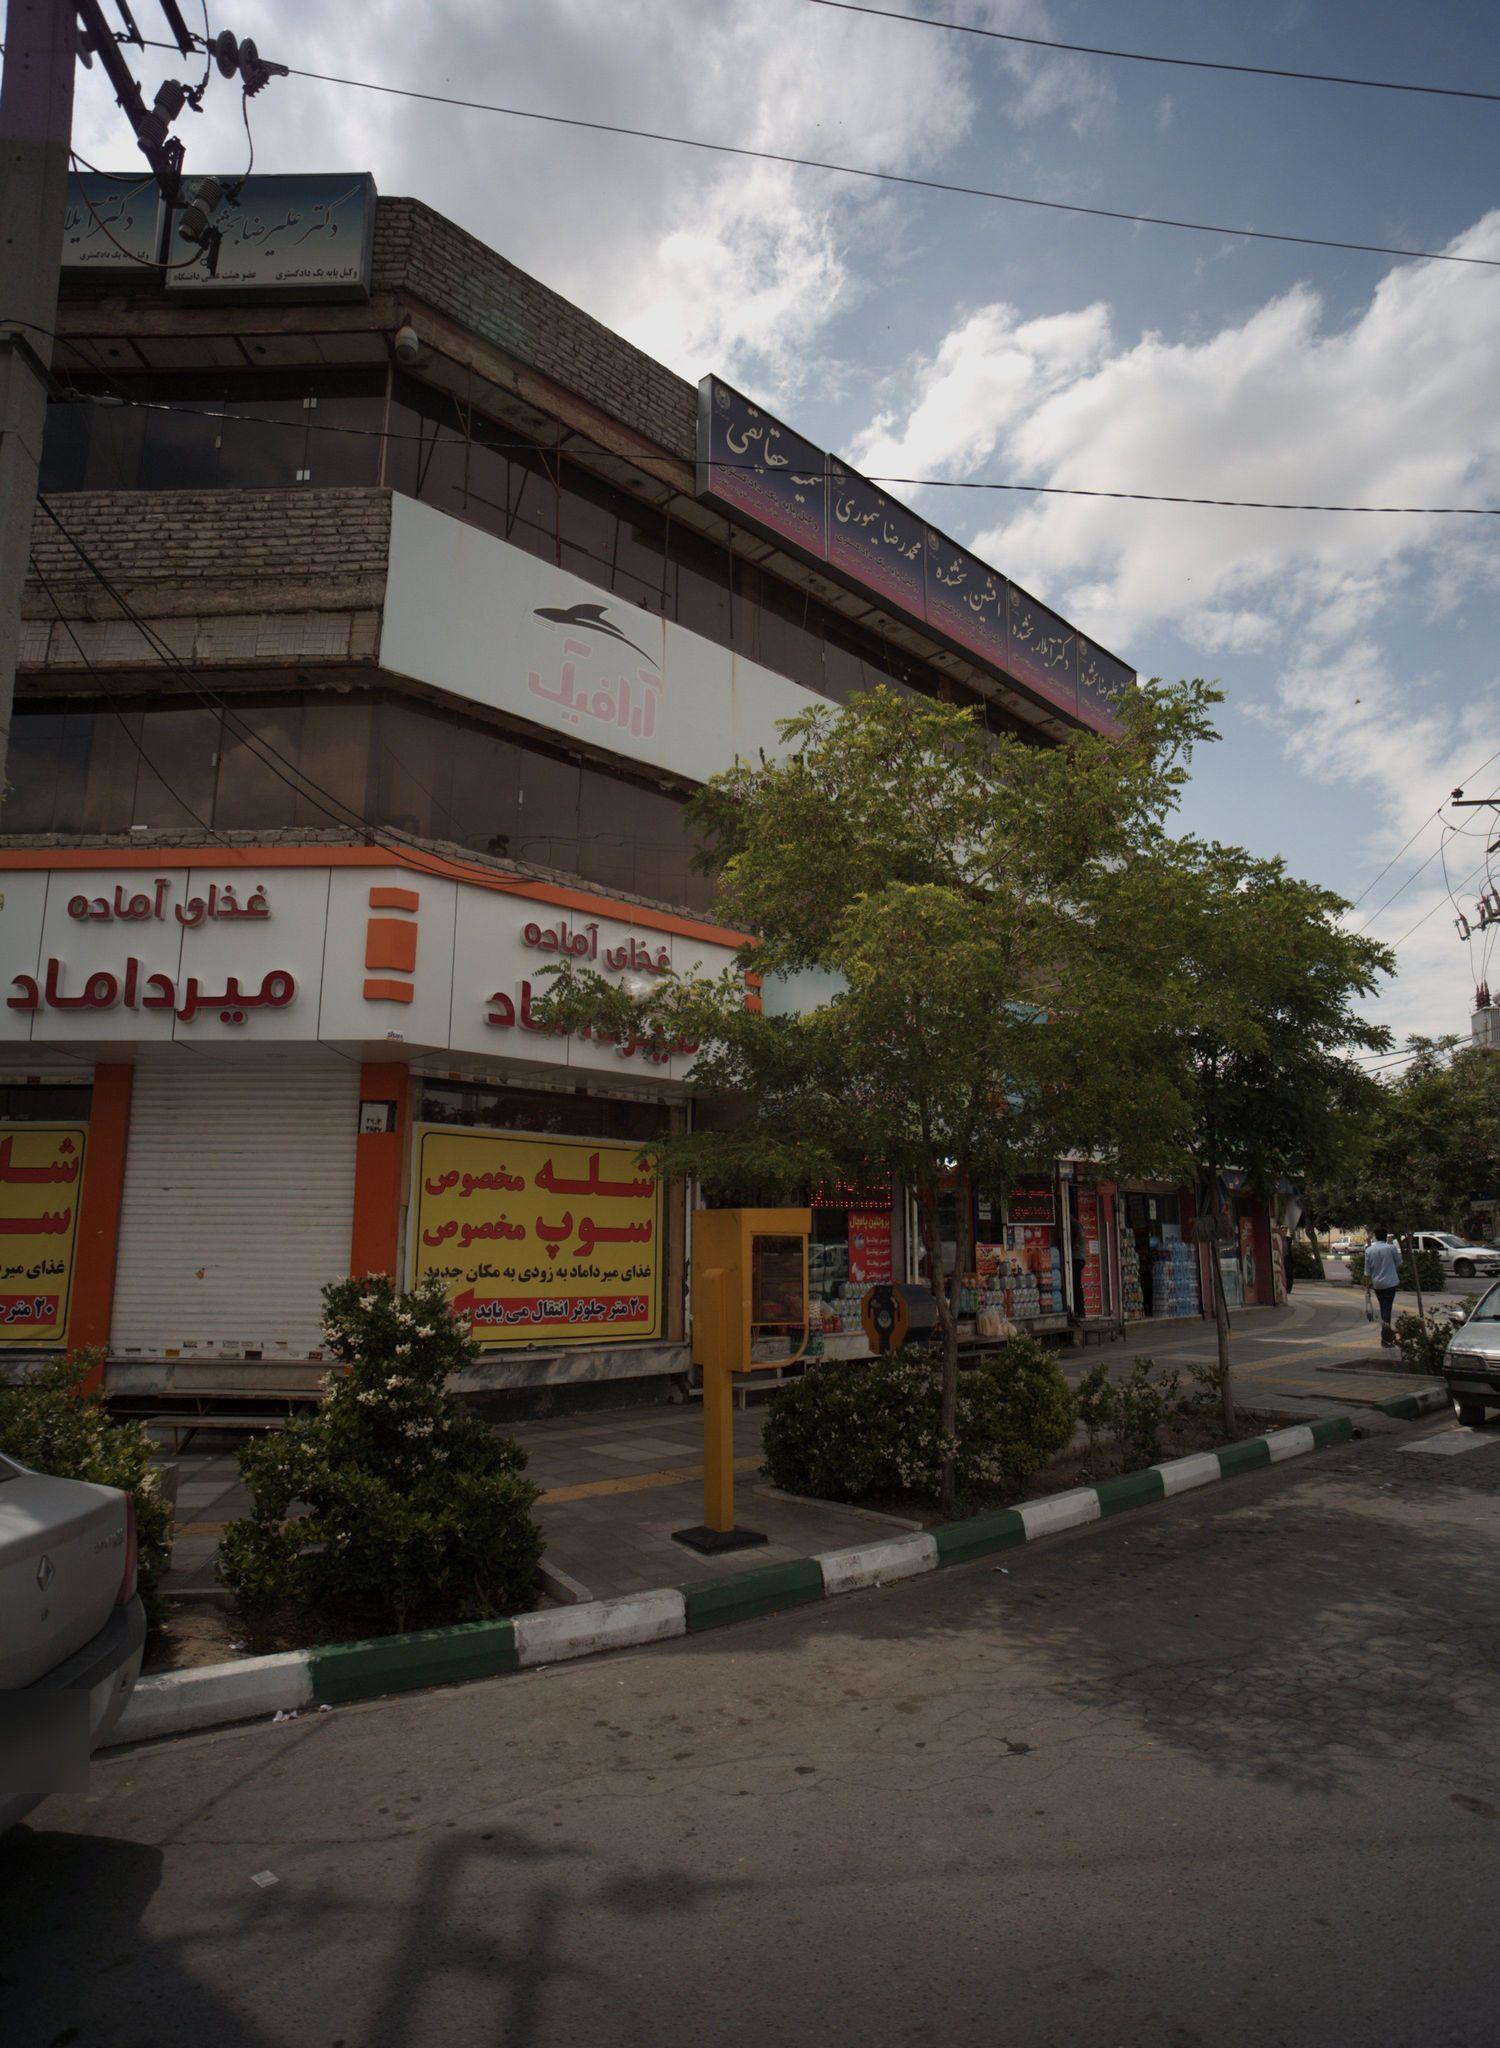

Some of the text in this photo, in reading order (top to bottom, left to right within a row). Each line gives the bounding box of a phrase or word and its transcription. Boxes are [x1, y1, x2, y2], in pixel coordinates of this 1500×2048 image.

[295, 184, 361, 246] دکتر
[242, 209, 301, 256] علیرضا
[275, 269, 312, 281] دادگستری
[339, 267, 358, 280] وکیل
[725, 406, 824, 504] سمیه حقایقی
[834, 496, 886, 545] تیموری
[935, 557, 969, 602] بخشنده
[968, 575, 1001, 623] افشین
[1050, 632, 1076, 672] دکتر
[67, 878, 271, 927] غذای آماده
[522, 920, 673, 976] غذای آماده
[6, 956, 297, 1025] میرداماد
[425, 1152, 656, 1198] شله مخصوص
[422, 1210, 654, 1260] سوپ مخصوص
[27, 1258, 66, 1280] غذای
[424, 1265, 464, 1283] جدید
[465, 1263, 501, 1282] مکان
[502, 1268, 517, 1283] به
[518, 1267, 555, 1282] زودی
[555, 1267, 568, 1282] به
[621, 1265, 652, 1282] غذای
[475, 1301, 503, 1320] یابد
[505, 1307, 530, 1323] می
[531, 1300, 569, 1323] انتقال
[570, 1303, 606, 1323] جلوتر
[608, 1301, 628, 1320] متر
